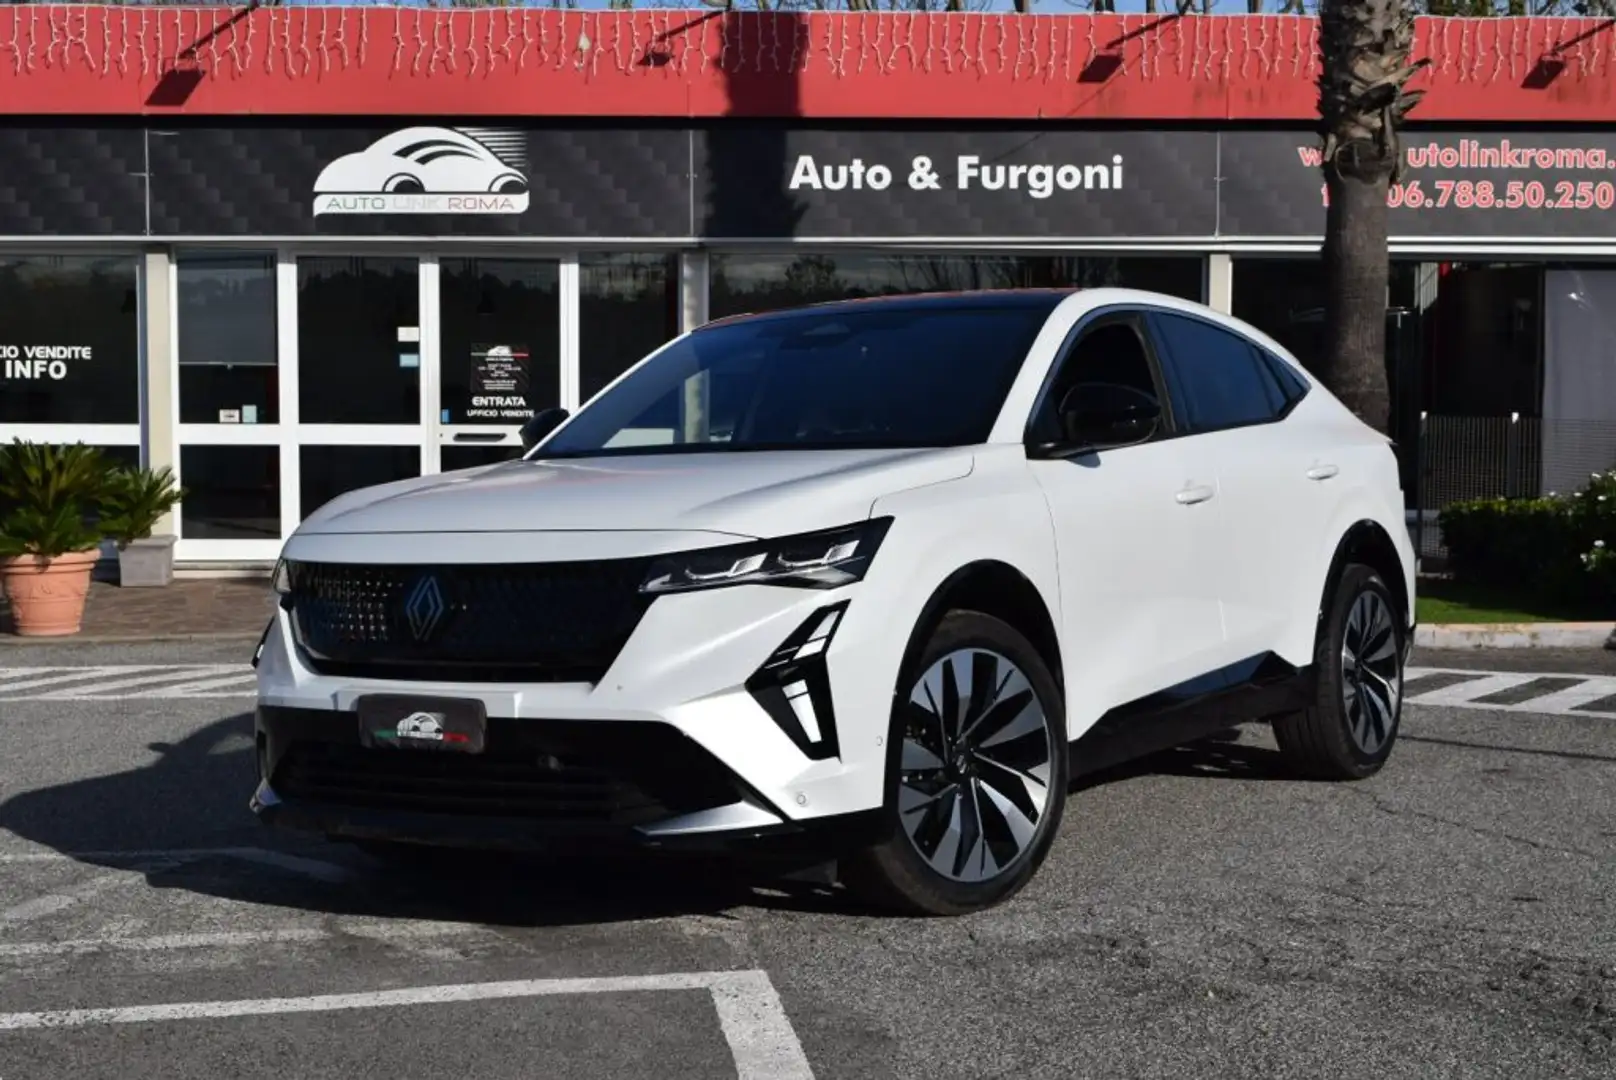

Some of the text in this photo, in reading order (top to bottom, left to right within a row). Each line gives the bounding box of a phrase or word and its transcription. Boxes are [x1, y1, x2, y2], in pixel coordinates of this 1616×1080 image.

[789, 154, 1123, 199] Auto & Furgoni
[1386, 179, 1615, 209] 06.788.50.250
[326, 197, 386, 210] AUTO
[448, 197, 515, 210] ROMA
[0, 345, 92, 360] IO VENDITE
[5, 359, 67, 380] INFO
[472, 396, 526, 407] ENTRATA
[466, 409, 498, 418] UFFICIO
